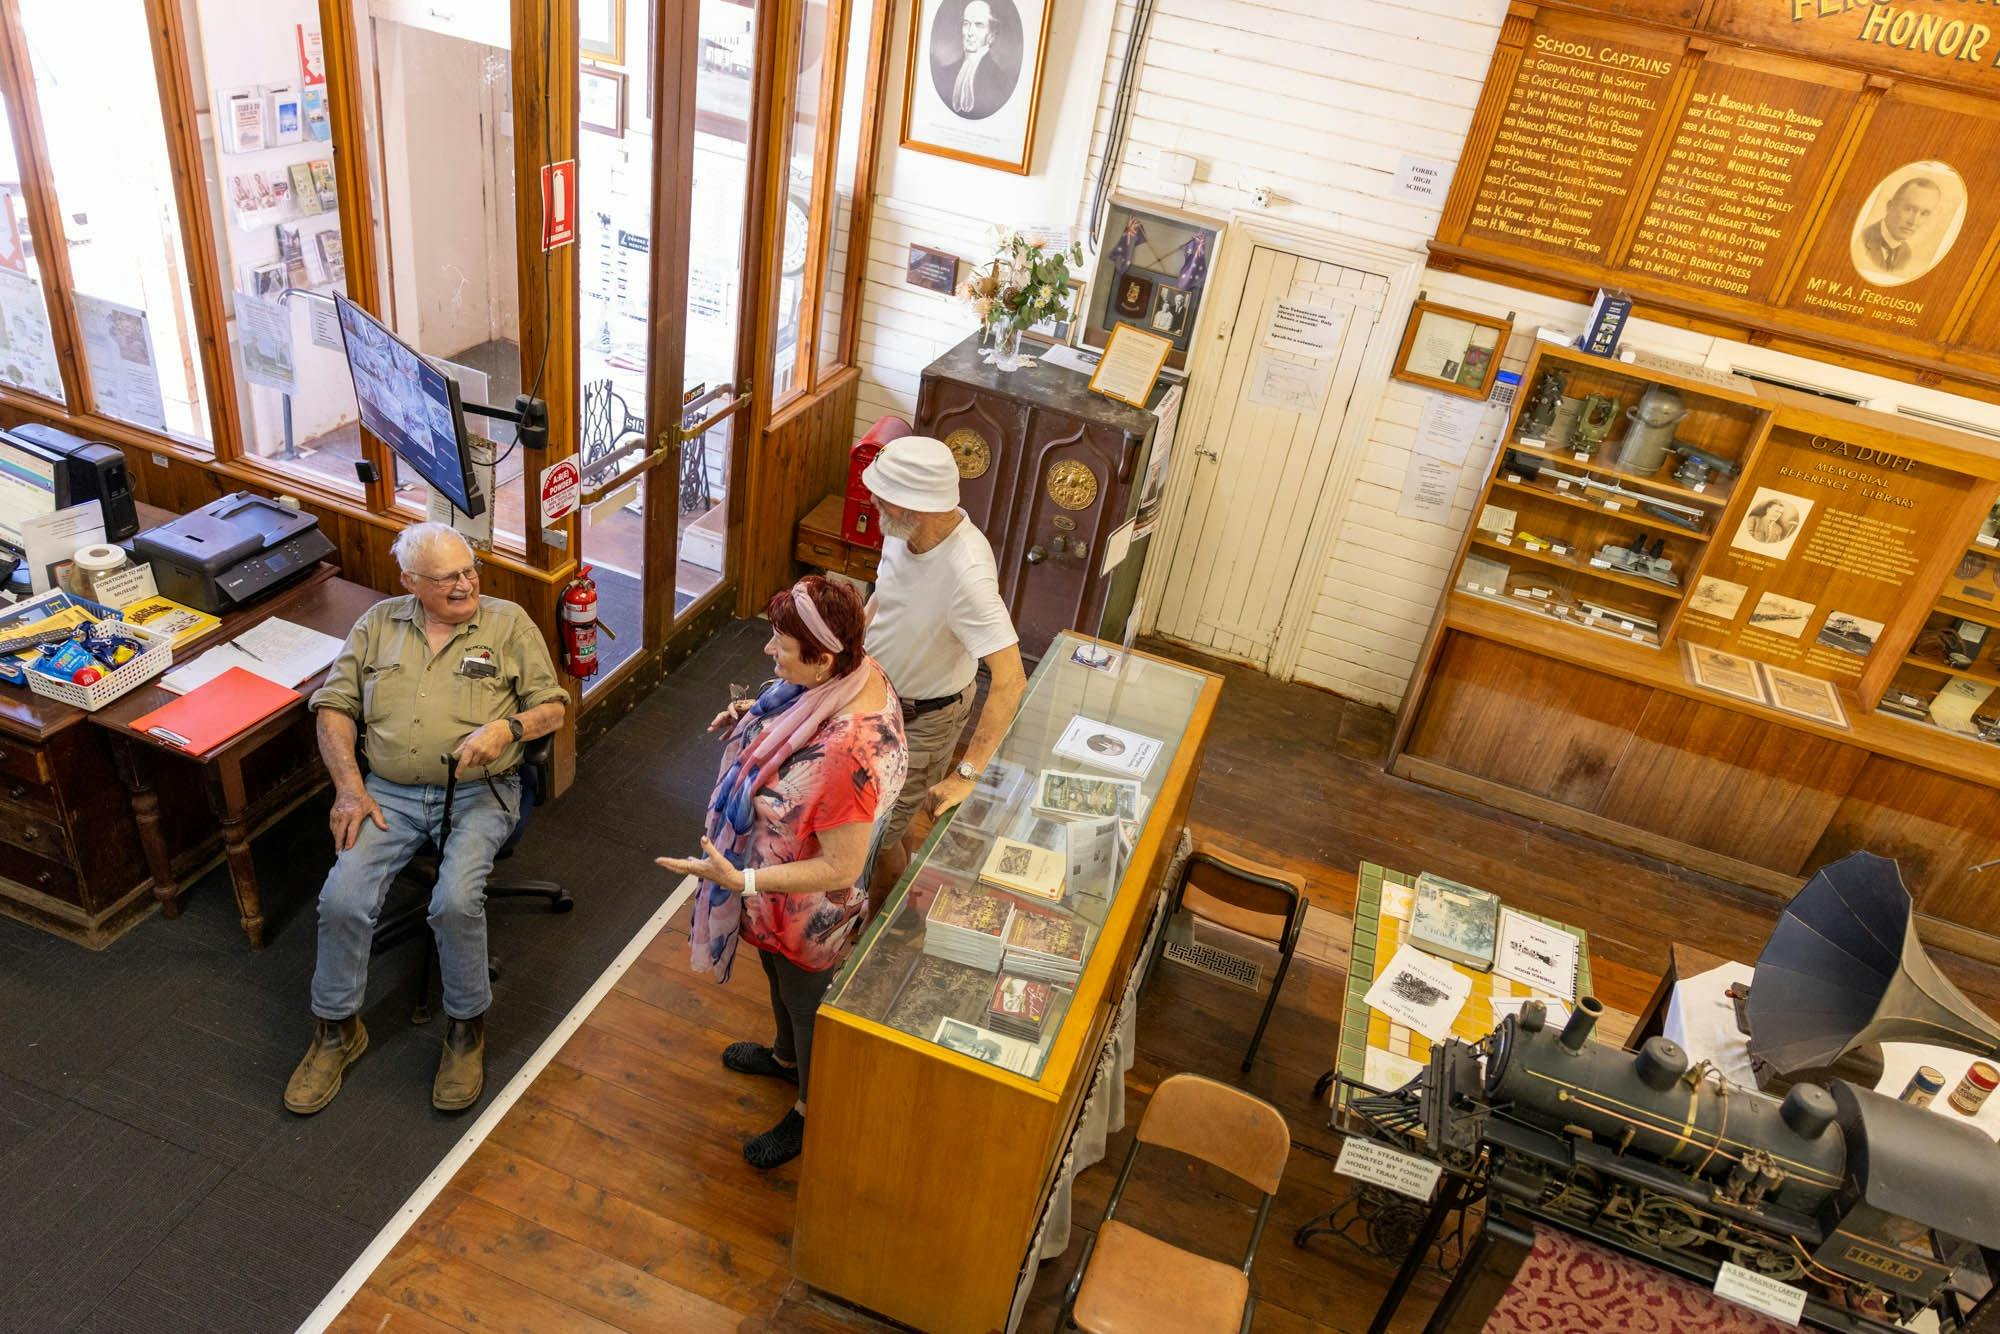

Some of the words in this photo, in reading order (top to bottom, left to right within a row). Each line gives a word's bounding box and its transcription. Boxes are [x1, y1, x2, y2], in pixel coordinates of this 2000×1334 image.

[1856, 4, 1991, 62] HONOR
[1534, 35, 1594, 59] SCHOOL
[1600, 47, 1671, 75] CAPTAINS
[1536, 59, 1567, 75] GORDON
[1600, 72, 1613, 84] IDA
[1615, 76, 1646, 91] SMART
[1588, 102, 1604, 114] ISLA
[1607, 106, 1639, 121] GAGGIN
[1602, 89, 1622, 103] NINA
[1622, 94, 1657, 110] VITNELL
[1757, 103, 1784, 119] HELEN
[1521, 104, 1544, 117] JOHN
[1609, 121, 1644, 138] BENSON
[1736, 115, 1781, 134] ELIZABETH
[1783, 125, 1816, 142] TREVOR
[1517, 118, 1544, 132] HAROLD
[1611, 139, 1638, 152] WOODS
[1738, 133, 1762, 145] JEAN
[1763, 139, 1806, 156] ROGERSON
[1494, 144, 1508, 153] 1930
[1509, 145, 1524, 157] RON
[1551, 153, 1580, 169] LAUREL
[1583, 161, 1623, 178] THOMPSON
[1512, 132, 1538, 145] HAROLD
[1581, 145, 1597, 157] LILY
[1597, 150, 1633, 166] BESGROVE
[1733, 146, 1759, 160] LORNA
[1761, 151, 1790, 167] PEAKE
[1412, 166, 1438, 177] FORBES
[1672, 149, 1686, 159] 1940
[1727, 160, 1756, 175] MURIEL
[1758, 166, 1792, 183] HOCKING
[1406, 183, 1432, 194] SCHOOL
[1413, 175, 1431, 185] HIGH
[1485, 175, 1501, 184] 1932
[1555, 186, 1579, 202] ROYAL
[1558, 171, 1585, 187] LAUREL
[1587, 177, 1627, 196] THOMPSON
[1666, 163, 1679, 172] 1941
[1732, 177, 1754, 189] JOAN
[1756, 181, 1784, 196] SPEIRS
[1480, 190, 1497, 199] 1933
[1656, 189, 1670, 199] 1943
[1719, 202, 1741, 215] JOAN
[1743, 207, 1774, 222] BAILEY
[1661, 175, 1675, 185] 1942
[1742, 193, 1765, 206] JOAN
[1766, 198, 1794, 213] BAILEY
[555, 223, 564, 233] FIRE
[1476, 204, 1491, 213] 1934
[1527, 213, 1550, 227] JOYCE
[1552, 218, 1591, 236] ROBINSON
[1706, 213, 1748, 231] MARGARET
[1750, 223, 1782, 238] THOMAS
[1472, 217, 1487, 227] 1935
[1533, 228, 1572, 246] MARGARET
[1574, 237, 1601, 253] TREVOR
[1644, 216, 1660, 227] 1945
[1700, 227, 1727, 242] MONA
[1729, 233, 1767, 251] BOYTON
[1639, 230, 1653, 240] 1946
[1736, 252, 1765, 267] SMITH
[1633, 244, 1649, 254] 1947
[1690, 257, 1724, 273] BERNICE
[1725, 265, 1751, 279] PRESS
[1683, 272, 1712, 285] JOYCE
[1713, 278, 1749, 294] HODDER
[1804, 294, 1865, 315] HEADMASTER
[1860, 290, 1924, 314] FERGUSON
[1855, 447, 1917, 472] DUFF
[549, 477, 573, 496] POWDER
[1779, 467, 1849, 491] REFERENCE
[1861, 489, 1915, 509] LIBRARY
[1815, 463, 1889, 488] MEMORIAL
[96, 572, 128, 589] DONATIONS
[136, 565, 149, 574] HELP
[106, 580, 132, 593] MAINTAIN
[134, 575, 144, 583] THE
[114, 585, 139, 597] MUSEUM
[1347, 1142, 1374, 1154] MODEL
[1378, 1151, 1403, 1163] STEAM
[1345, 1160, 1371, 1172] MODEL
[1376, 1169, 1398, 1180] TRAIN
[1347, 1151, 1384, 1166] DONATED
[1400, 1168, 1428, 1181] FORBES
